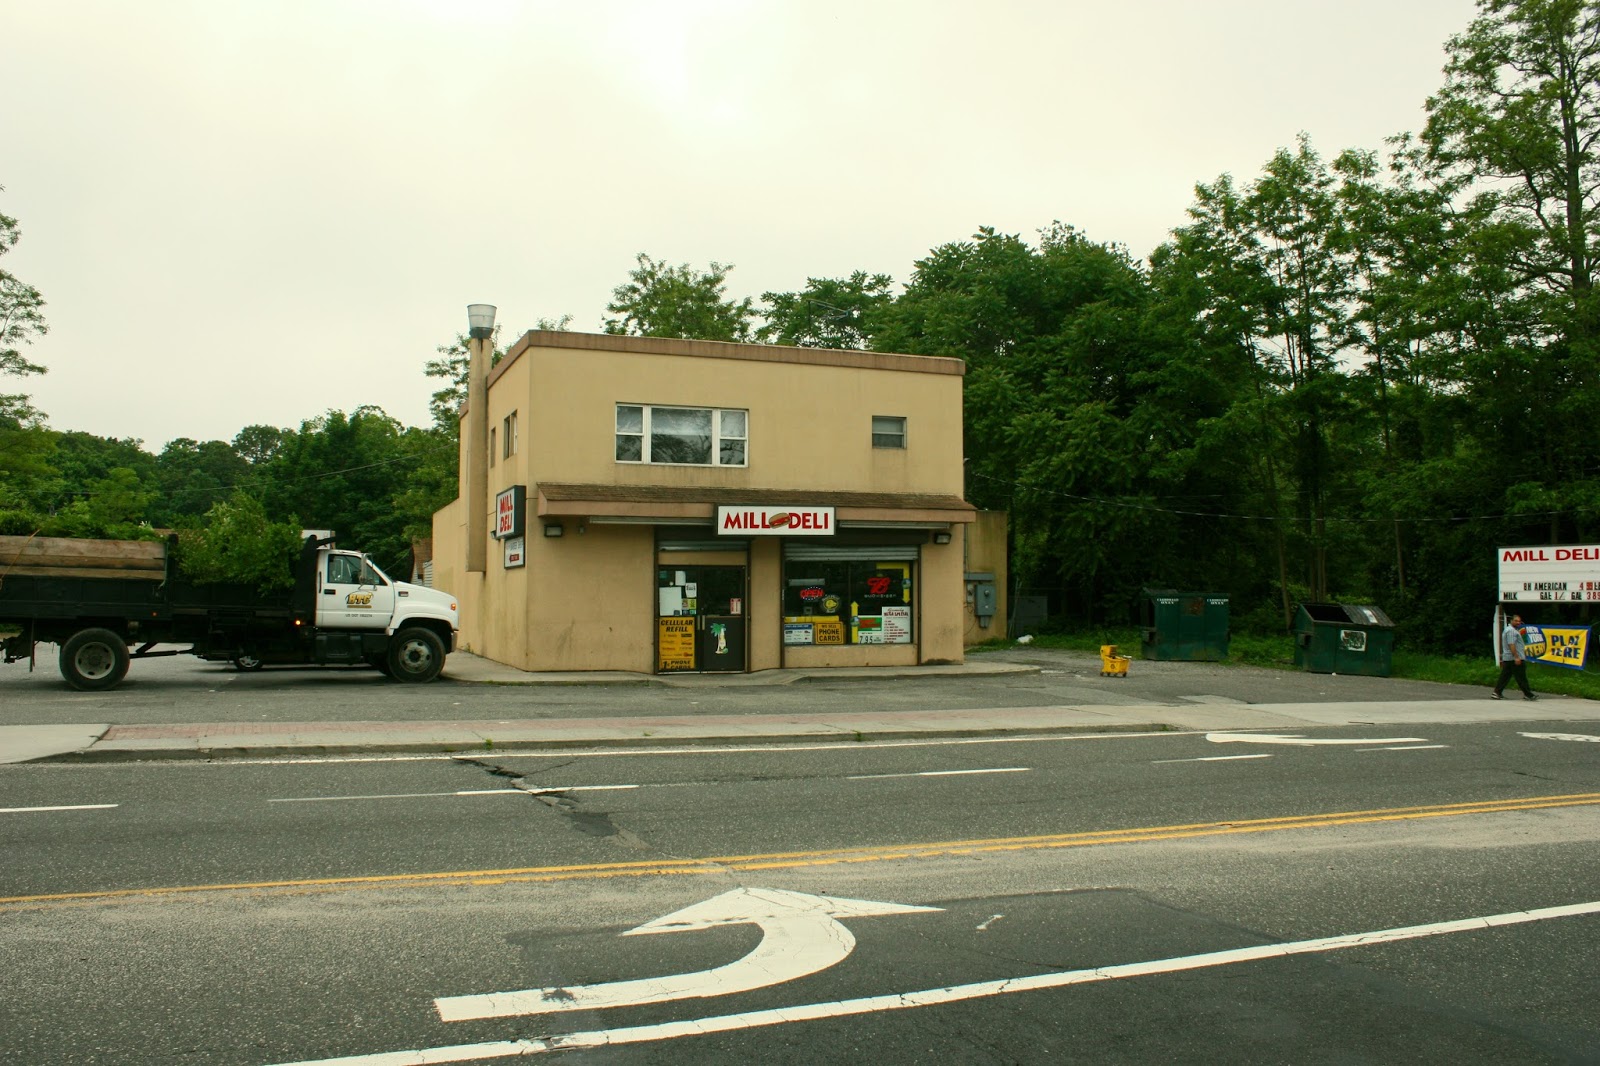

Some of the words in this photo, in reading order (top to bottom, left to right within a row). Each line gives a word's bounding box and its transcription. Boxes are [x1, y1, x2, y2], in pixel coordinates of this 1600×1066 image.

[500, 494, 513, 515] MILL
[500, 513, 513, 533] DELI
[723, 511, 771, 530] MILL
[788, 511, 829, 530] DELI
[1503, 549, 1550, 562] MILL
[1556, 548, 1600, 561] DELI
[1534, 581, 1567, 591] AMERICAN
[1503, 591, 1518, 601] MILK
[1526, 626, 1539, 634] NEW
